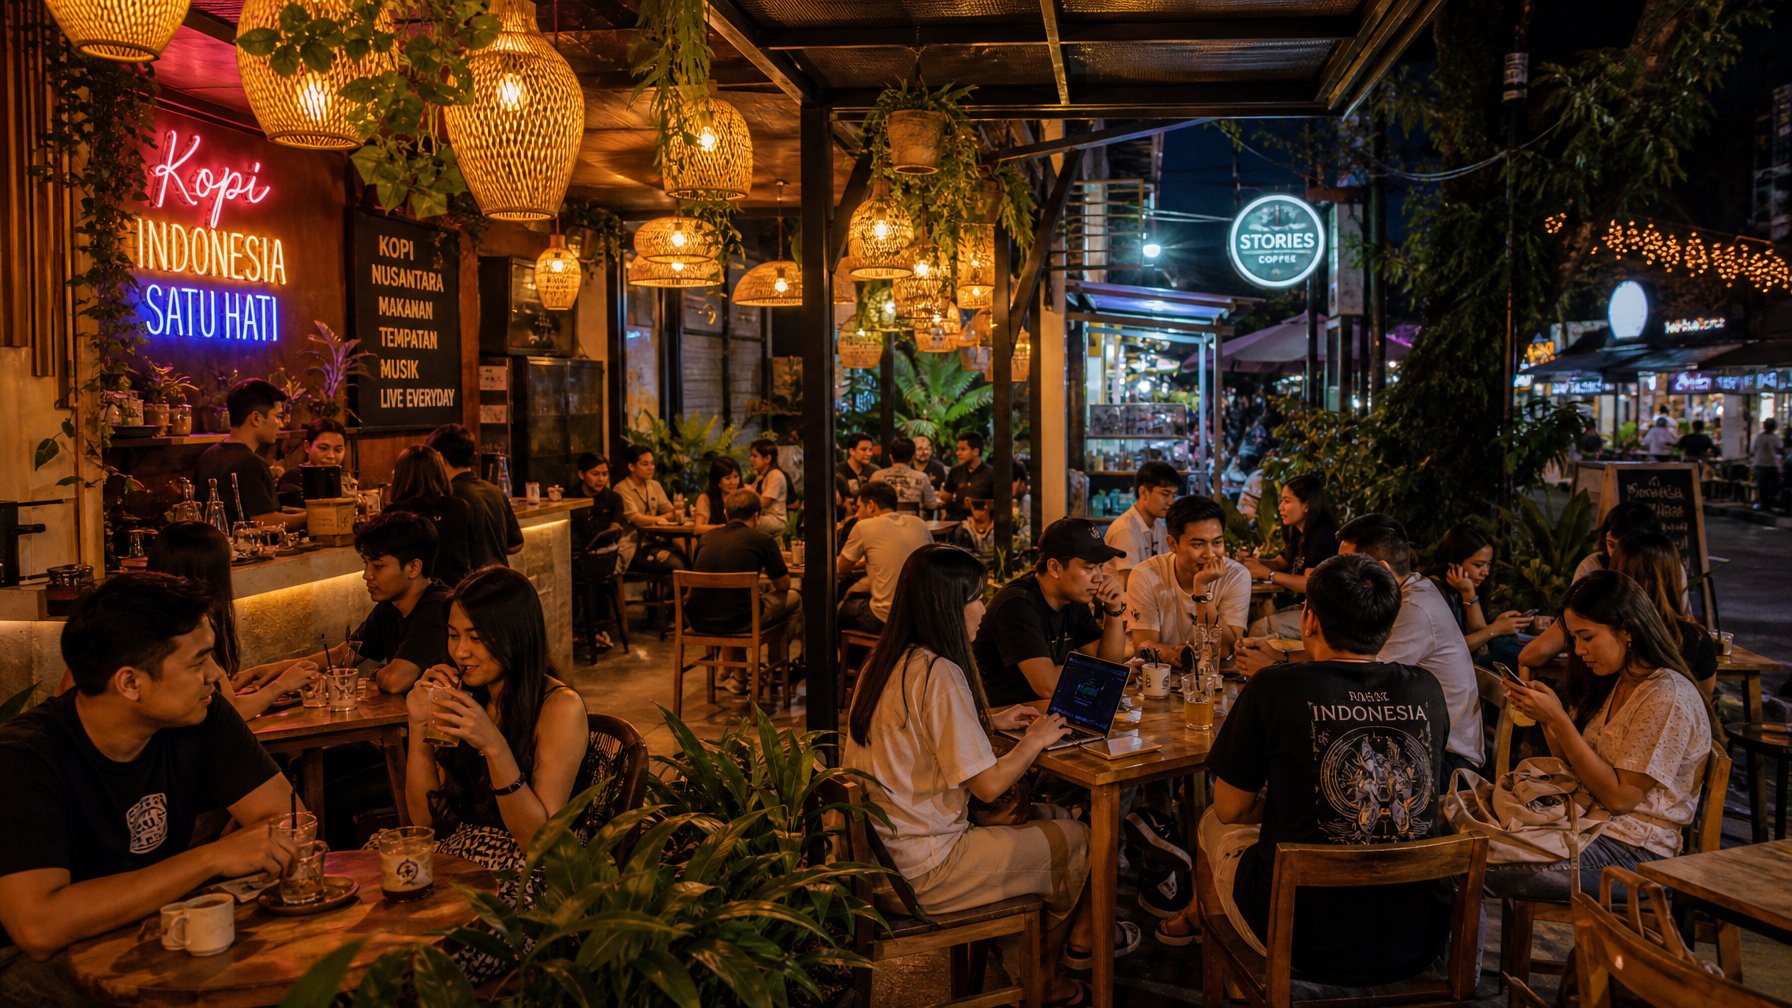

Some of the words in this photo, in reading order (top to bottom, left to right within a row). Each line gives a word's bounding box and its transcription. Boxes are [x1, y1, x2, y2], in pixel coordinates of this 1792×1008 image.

[155, 130, 270, 229] Kopi
[137, 218, 287, 285] INDONESIA
[379, 235, 414, 261] KOPI
[1240, 233, 1315, 249] STORIES
[372, 264, 444, 292] NUSANTARA
[146, 284, 215, 338] SATU
[225, 291, 278, 342] HATI
[379, 296, 433, 320] MAKANAN
[379, 326, 438, 350] TEMPATAN
[380, 359, 419, 379] MUSIK
[380, 388, 404, 408] LIVE
[406, 388, 455, 408] EVERYDAY
[1312, 705, 1427, 721] INDONESIA
